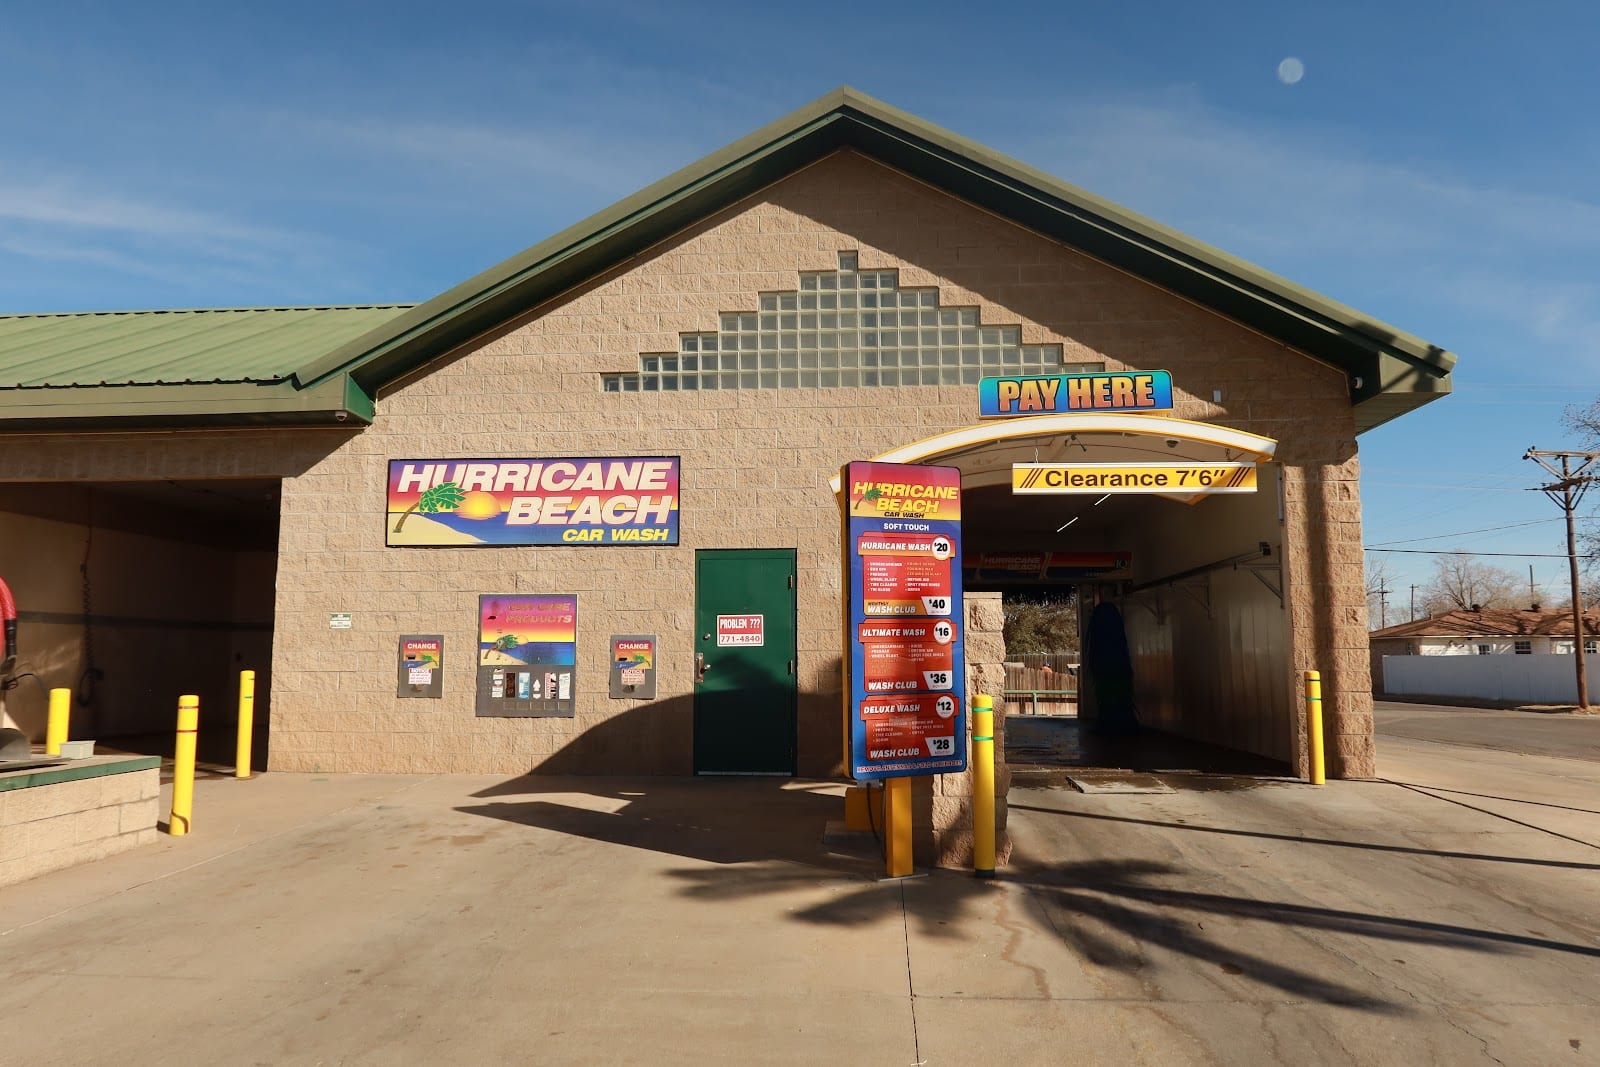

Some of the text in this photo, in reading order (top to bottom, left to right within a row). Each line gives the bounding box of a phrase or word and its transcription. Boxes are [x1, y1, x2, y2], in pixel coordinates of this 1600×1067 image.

[997, 375, 1156, 413] PAY HERE
[397, 461, 673, 493] HURRICANE
[1045, 469, 1168, 487] Clearance
[853, 481, 959, 500] HURRICANE
[506, 495, 673, 525] BEACH
[876, 498, 940, 513] BEACH
[563, 528, 669, 542] CAR WASH
[861, 541, 931, 551] HURRICANE WASH
[720, 618, 760, 629] PROBLEM ???
[862, 628, 901, 637] ULTIMATE
[868, 681, 917, 690] WASH CLUB
[863, 705, 920, 714] DELUXE WASH
[869, 748, 920, 758] WASH CLUB
